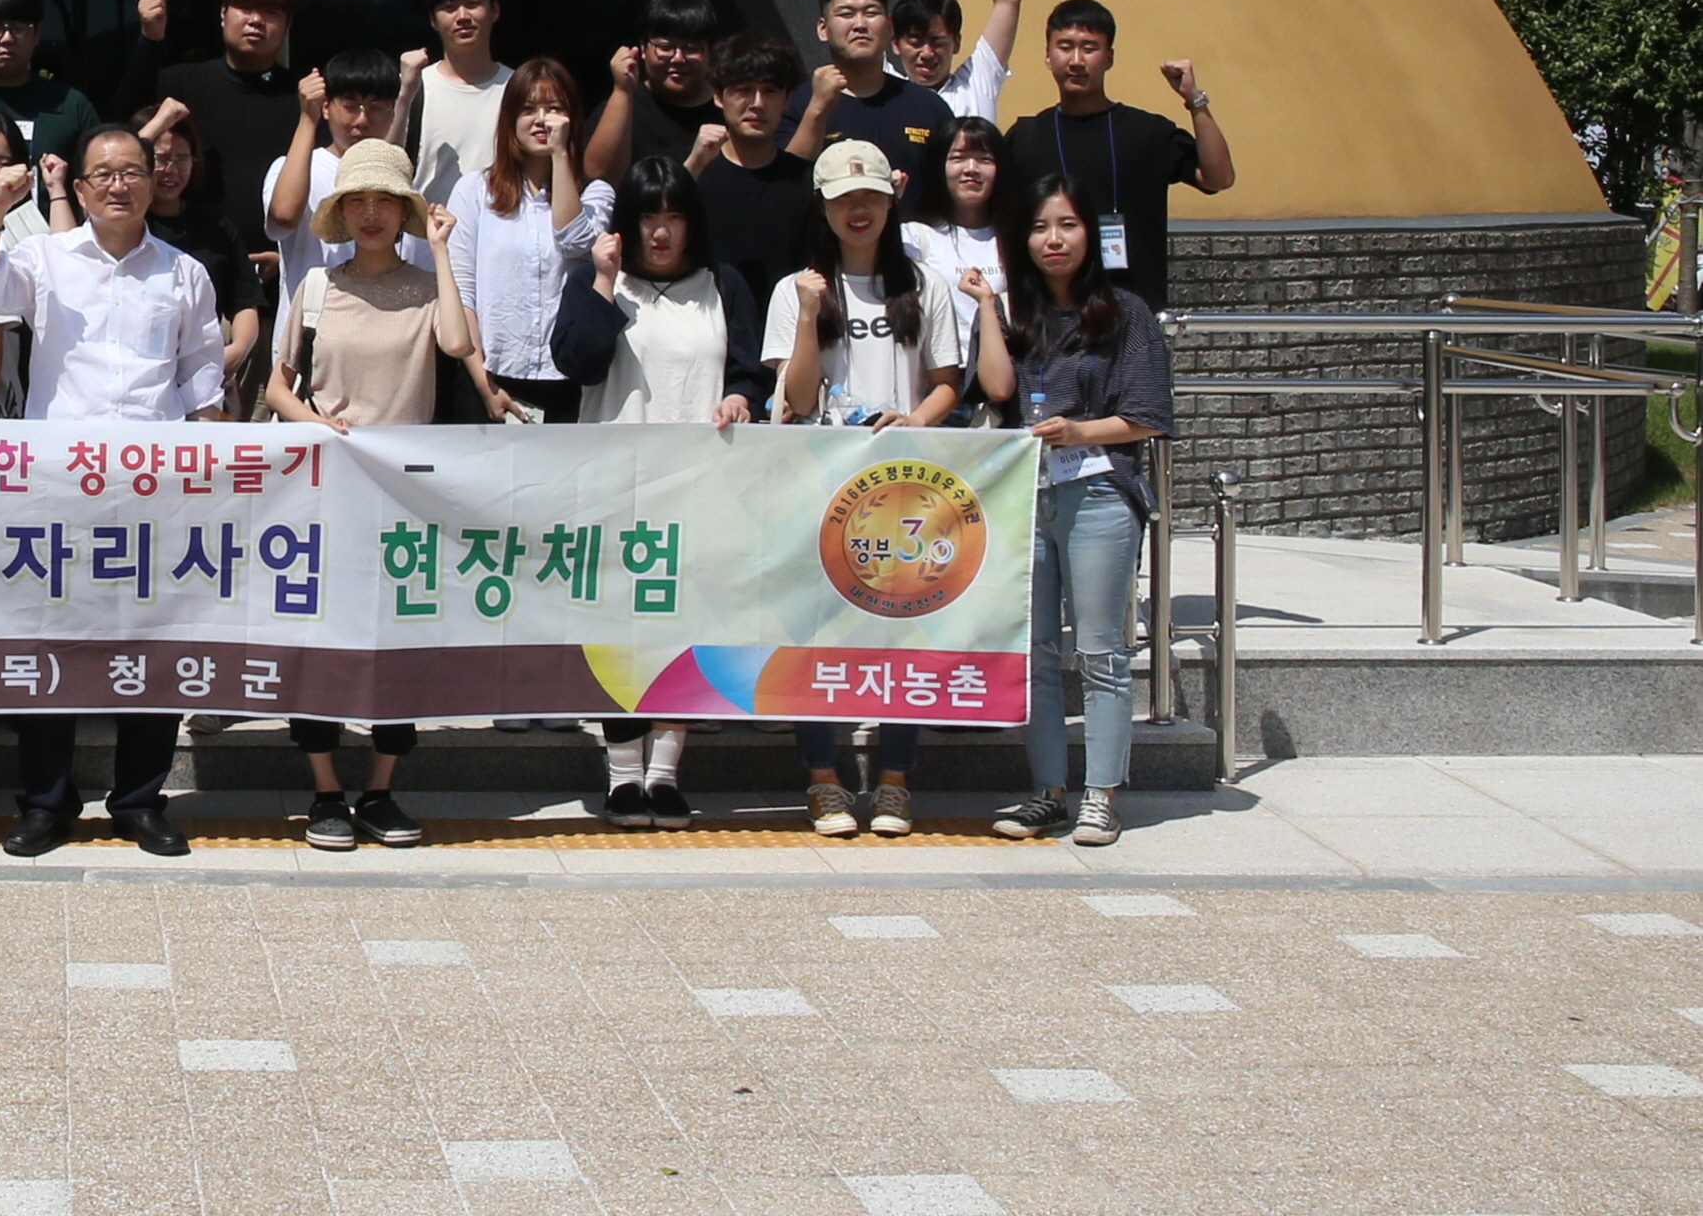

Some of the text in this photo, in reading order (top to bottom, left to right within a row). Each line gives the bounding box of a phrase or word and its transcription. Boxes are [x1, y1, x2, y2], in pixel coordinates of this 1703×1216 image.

[66, 439, 322, 496] 청양만들기
[379, 520, 682, 618] 현장체험
[849, 538, 892, 564] 정부
[811, 661, 989, 709] 부자농촌
